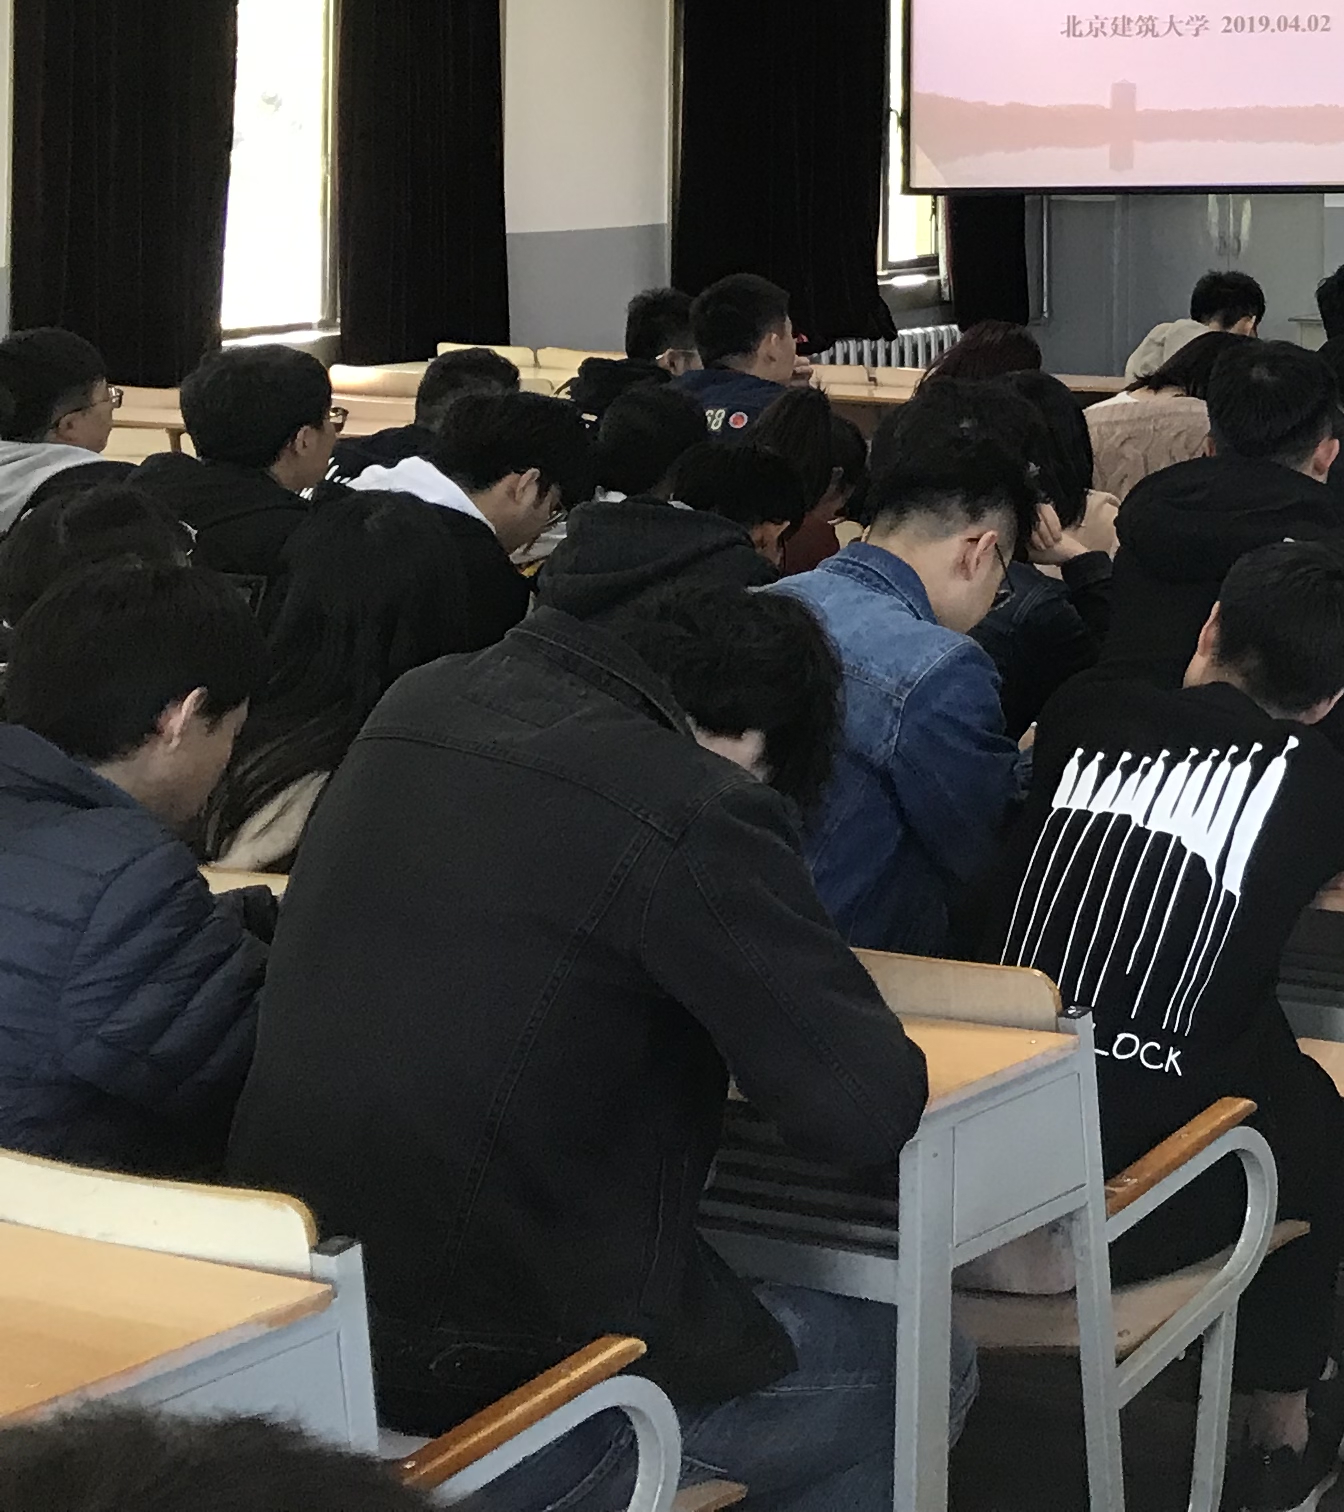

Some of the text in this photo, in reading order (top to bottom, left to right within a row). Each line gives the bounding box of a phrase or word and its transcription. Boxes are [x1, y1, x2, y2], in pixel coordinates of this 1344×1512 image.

[1060, 14, 1332, 39] 北京建筑大学 2019.04.02
